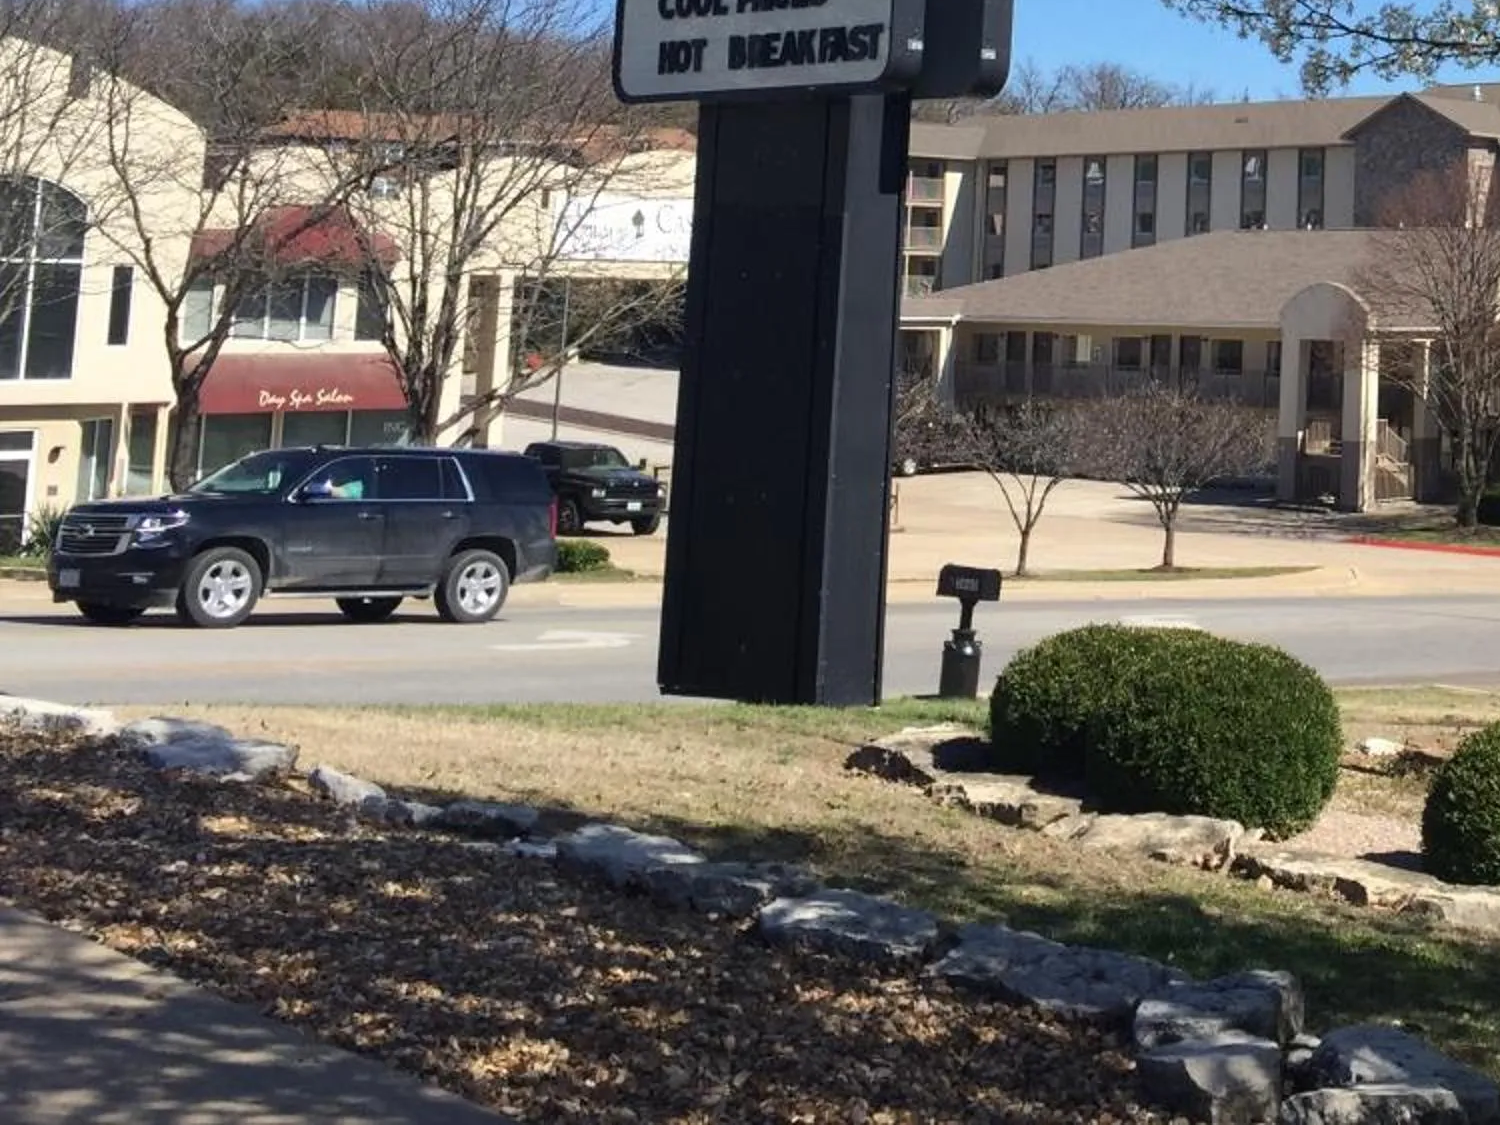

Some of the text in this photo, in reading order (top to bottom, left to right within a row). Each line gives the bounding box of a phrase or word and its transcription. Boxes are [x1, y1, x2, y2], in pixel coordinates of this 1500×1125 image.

[658, 23, 885, 75] HOT BREAKFAST
[259, 388, 353, 409] Day Spa Salon
